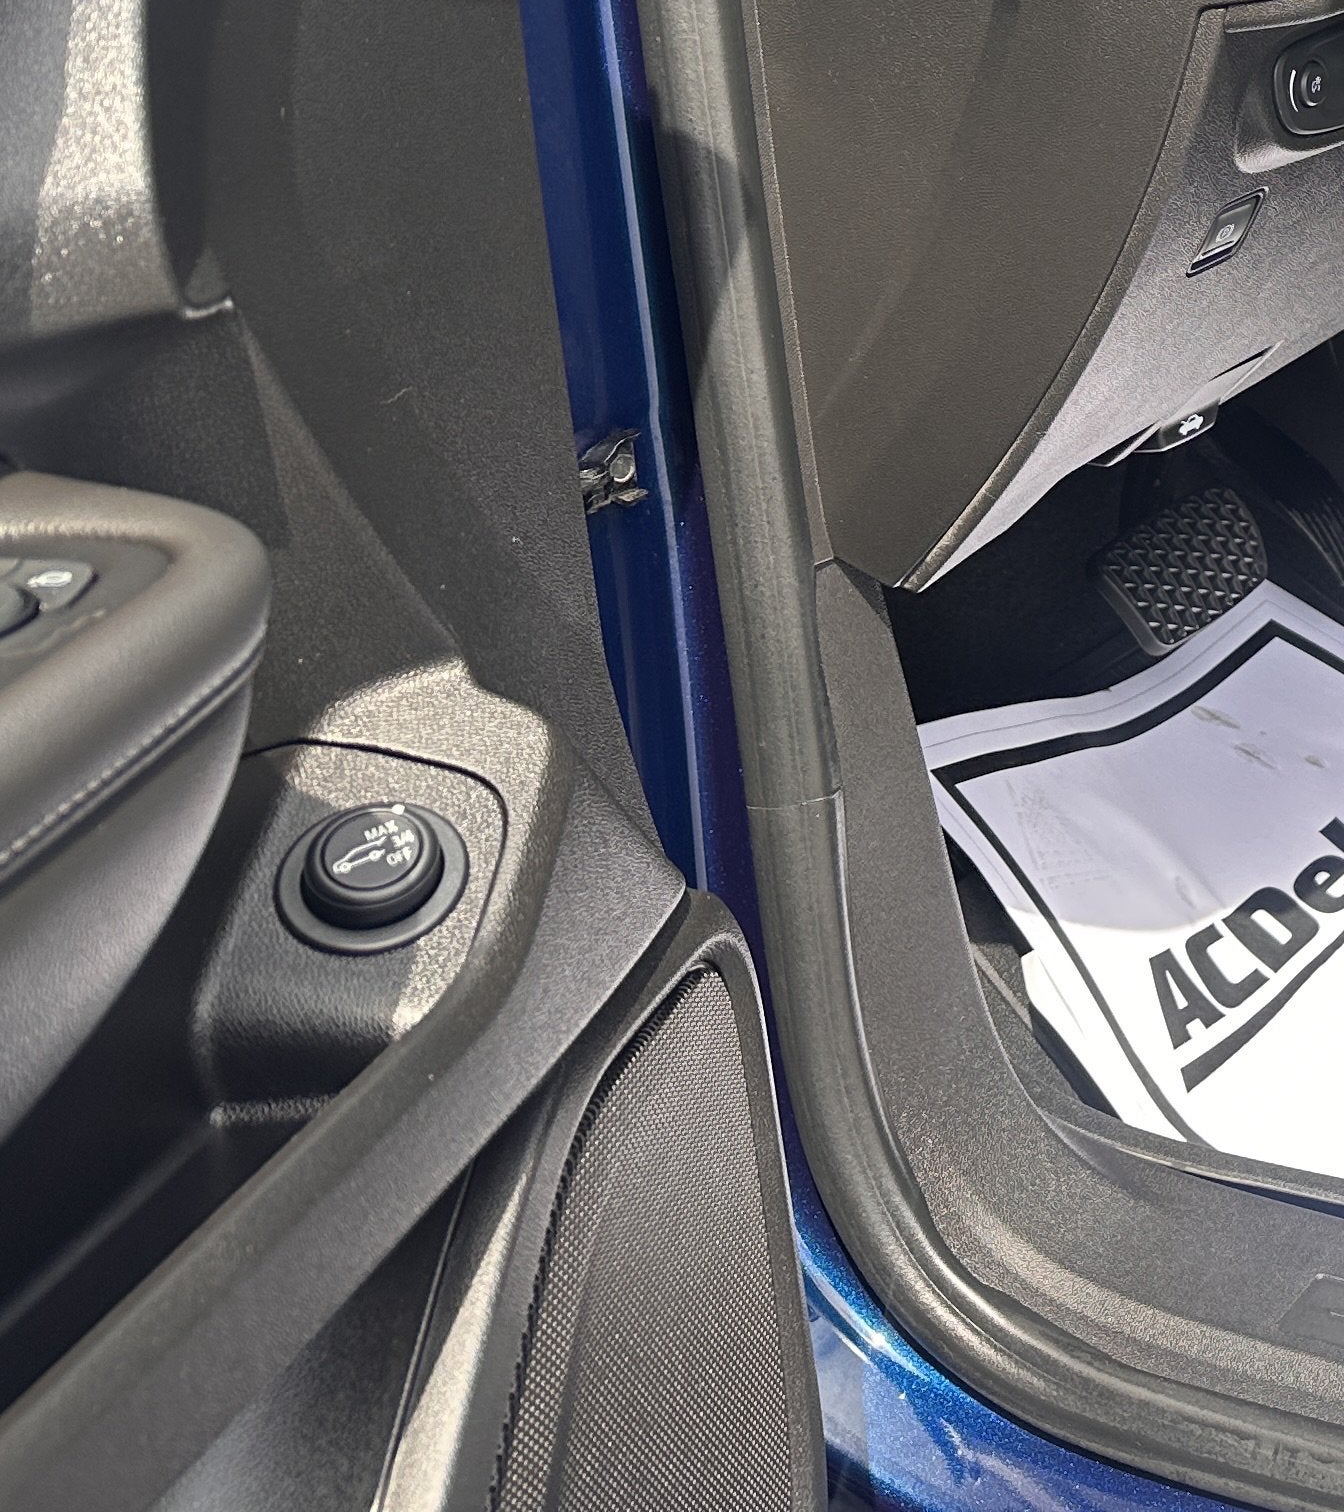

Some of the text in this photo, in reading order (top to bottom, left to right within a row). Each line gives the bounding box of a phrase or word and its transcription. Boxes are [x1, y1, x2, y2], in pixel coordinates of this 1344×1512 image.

[364, 820, 398, 841] MAX
[391, 829, 415, 848] 3/4
[386, 846, 412, 866] OFF
